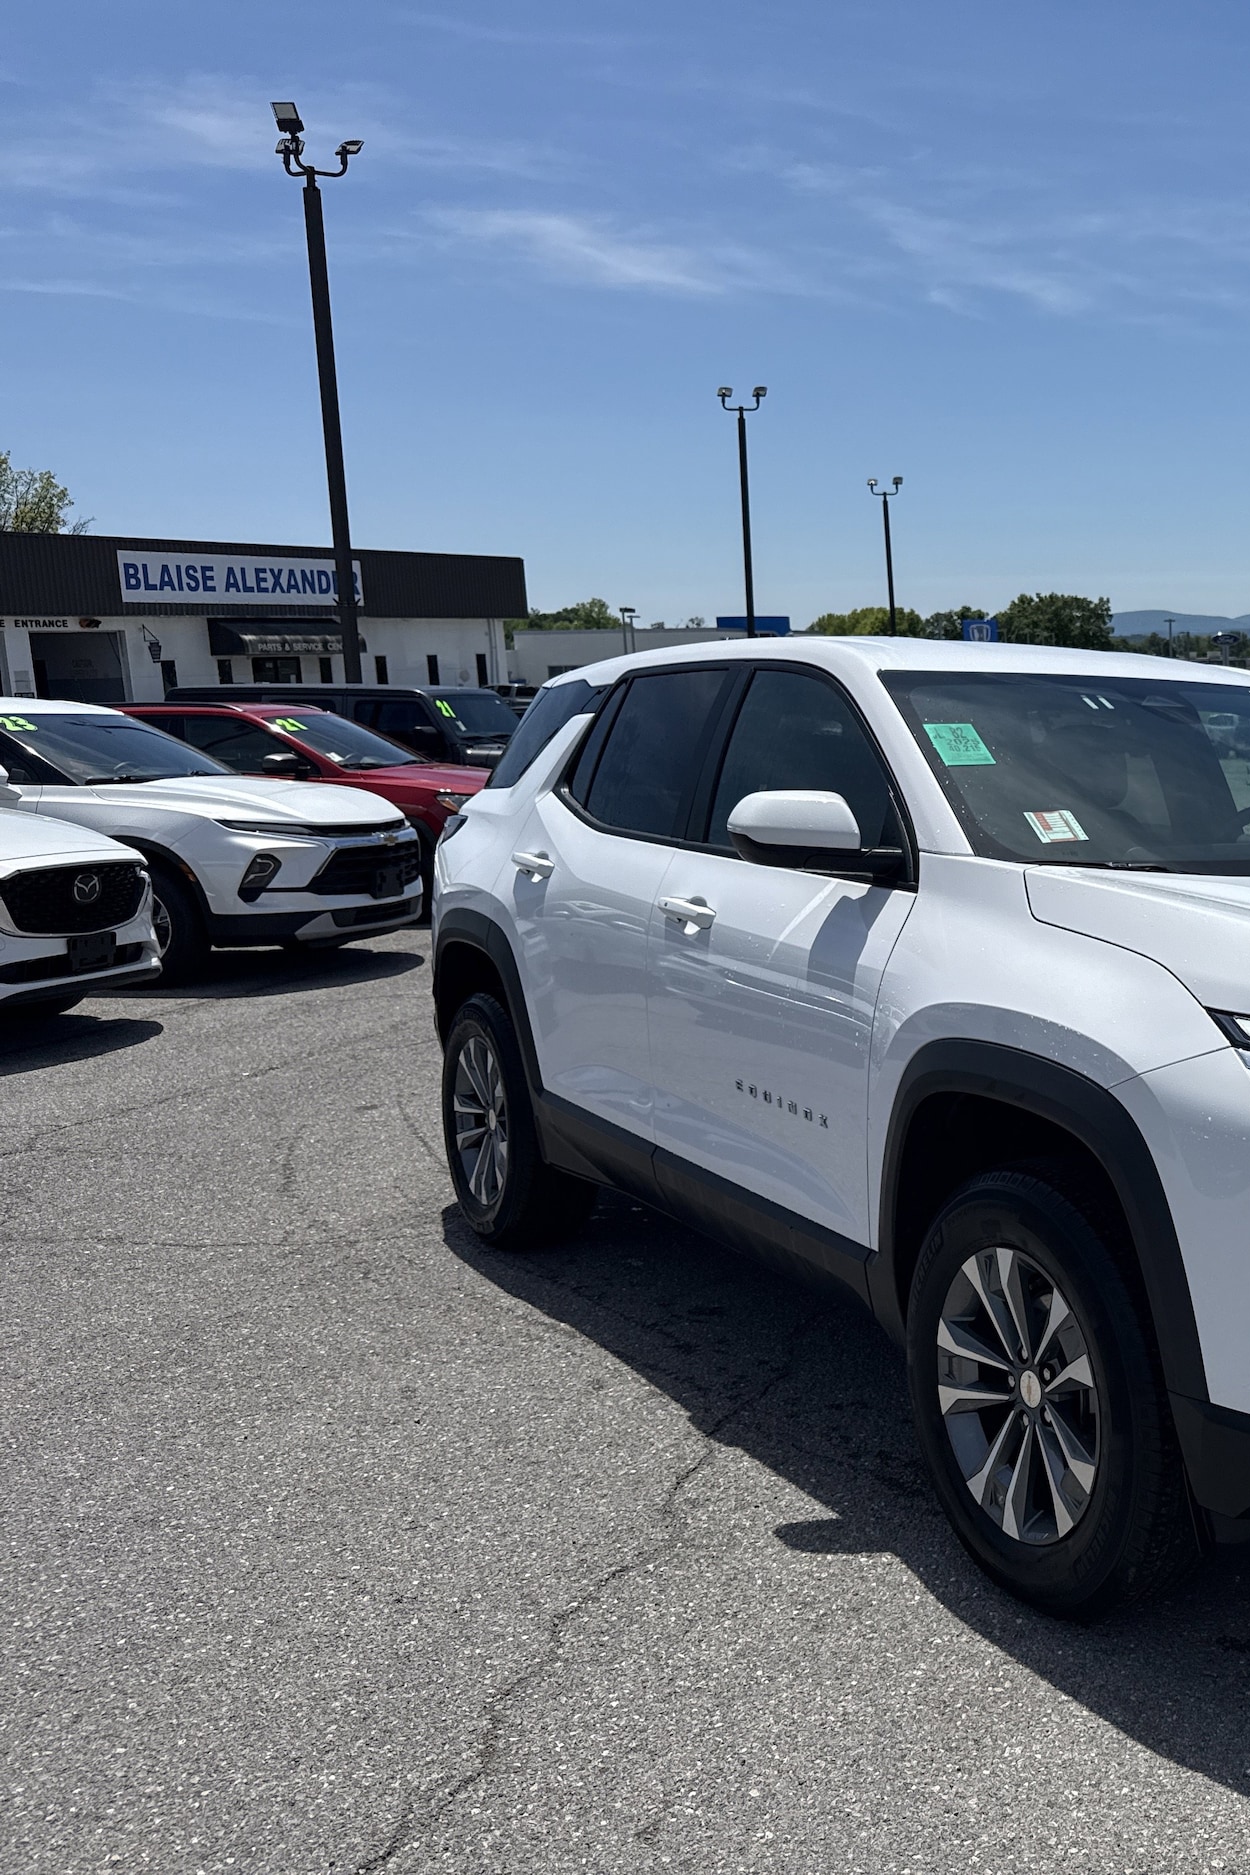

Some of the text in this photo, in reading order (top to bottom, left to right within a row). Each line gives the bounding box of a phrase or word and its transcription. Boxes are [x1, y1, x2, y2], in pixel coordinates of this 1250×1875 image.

[123, 562, 216, 593] BLAISE
[14, 619, 69, 628] ENTRANCE
[258, 643, 282, 652] PARTS
[293, 642, 323, 651] SERVICE
[434, 699, 457, 719] 21
[0, 715, 38, 732] 23
[275, 717, 309, 732] 21
